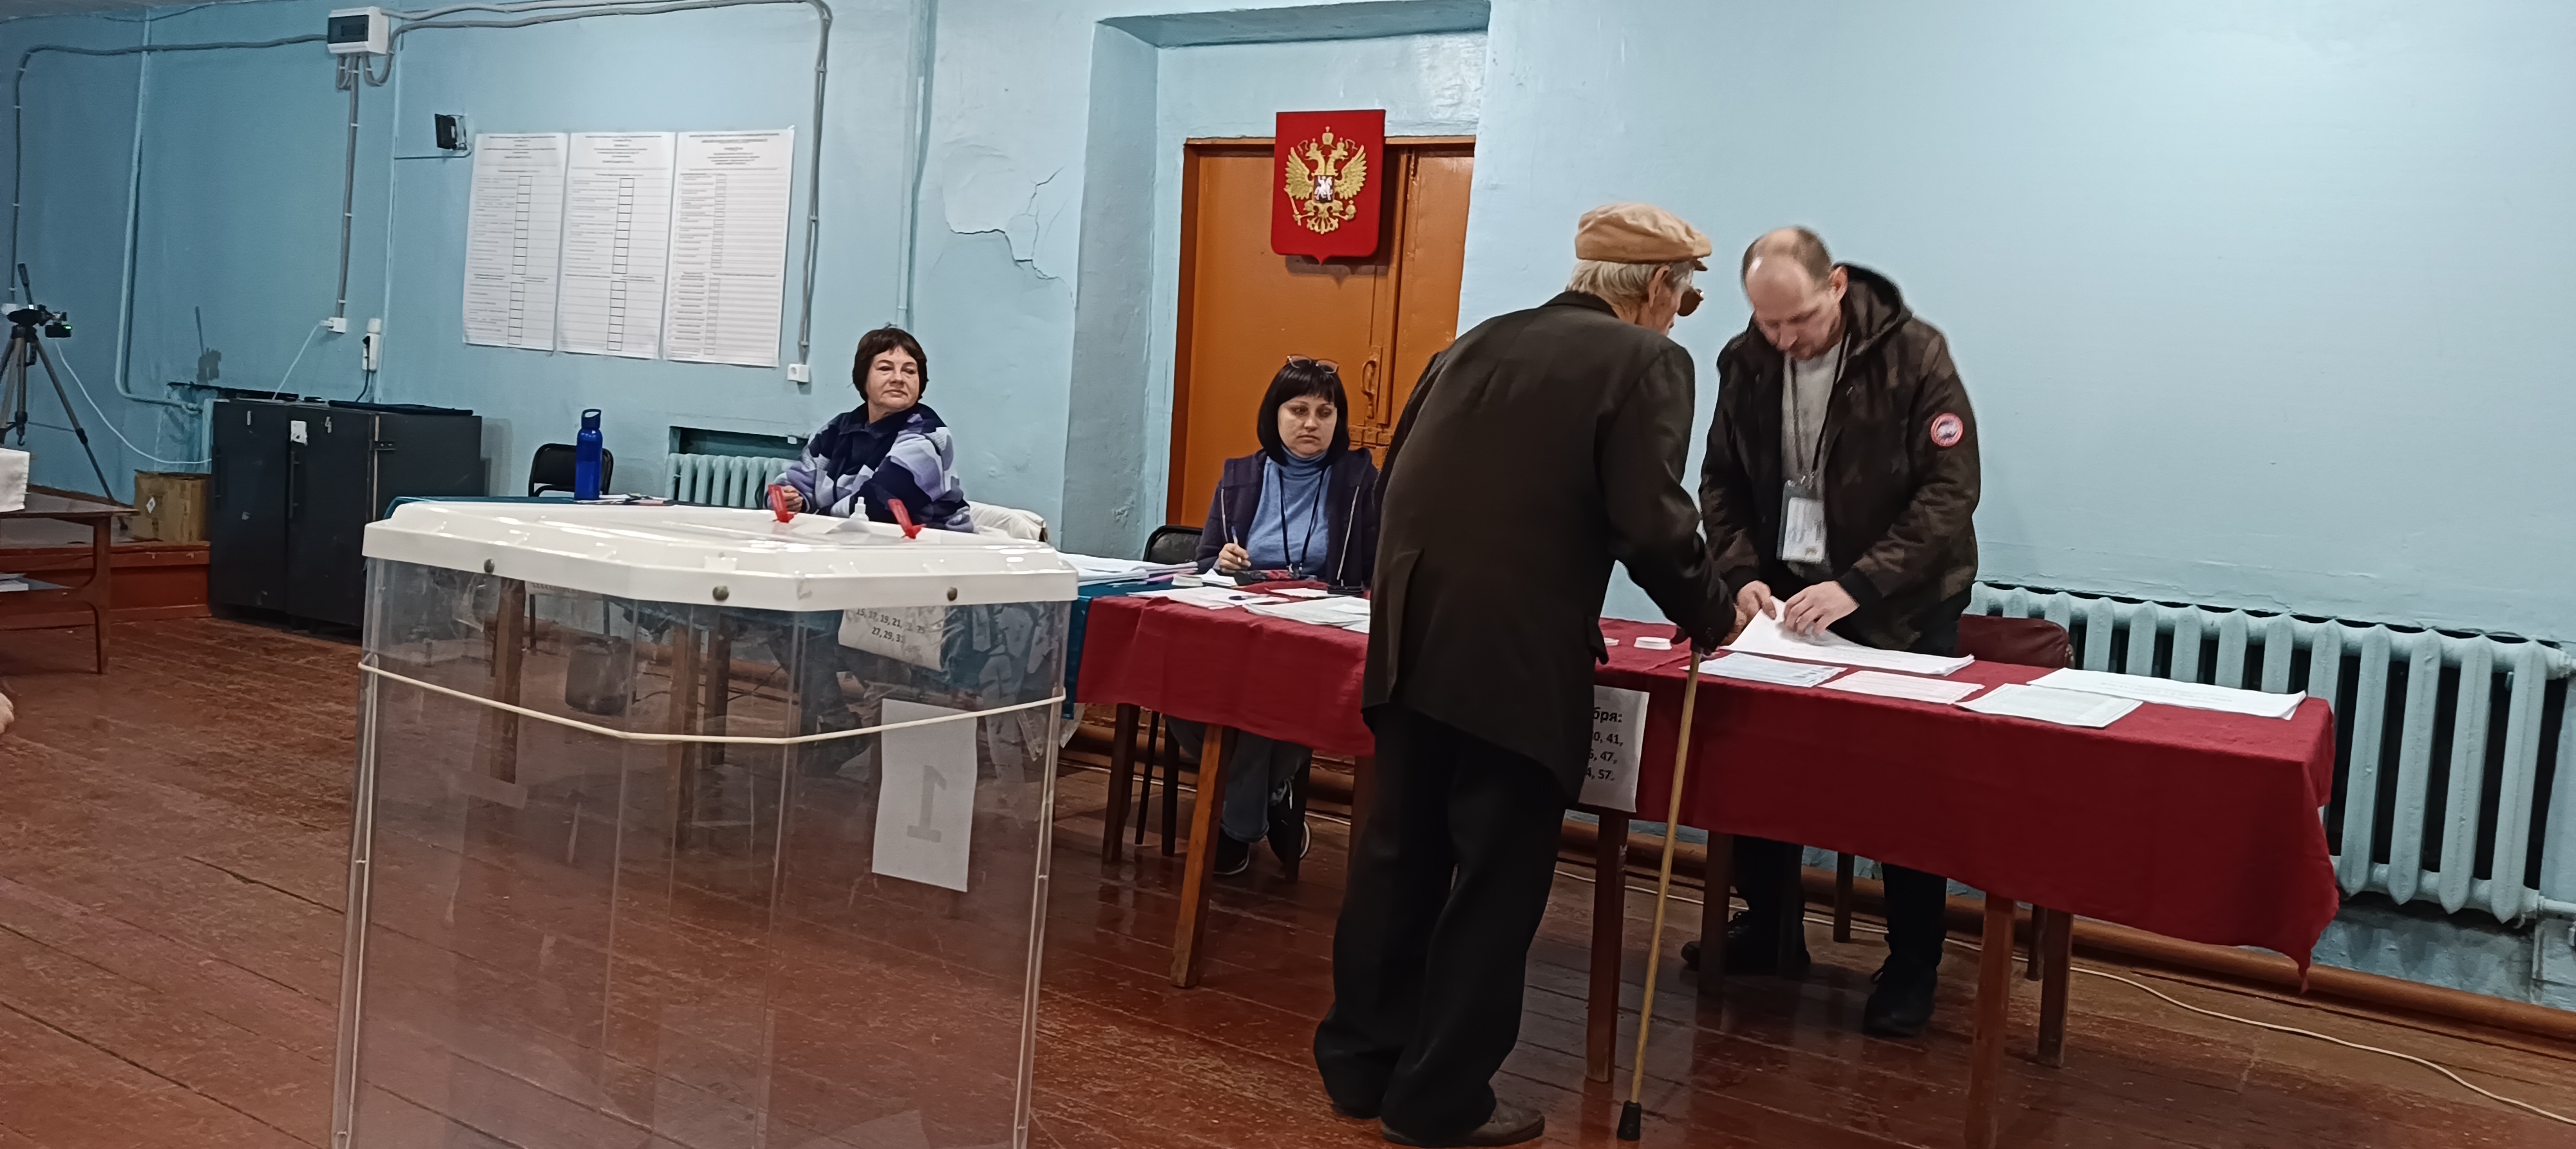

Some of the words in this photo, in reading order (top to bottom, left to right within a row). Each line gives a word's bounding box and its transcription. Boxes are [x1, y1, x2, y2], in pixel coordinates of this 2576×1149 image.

[880, 614, 891, 626] 19,
[891, 618, 903, 629] 21,
[871, 626, 882, 638] 27,
[883, 630, 895, 641] 29,
[1593, 707, 1622, 723] бря:
[1593, 731, 1604, 744] 0,
[1605, 733, 1624, 747] 41,
[1600, 751, 1618, 764] 47,
[1597, 768, 1615, 781] 57.
